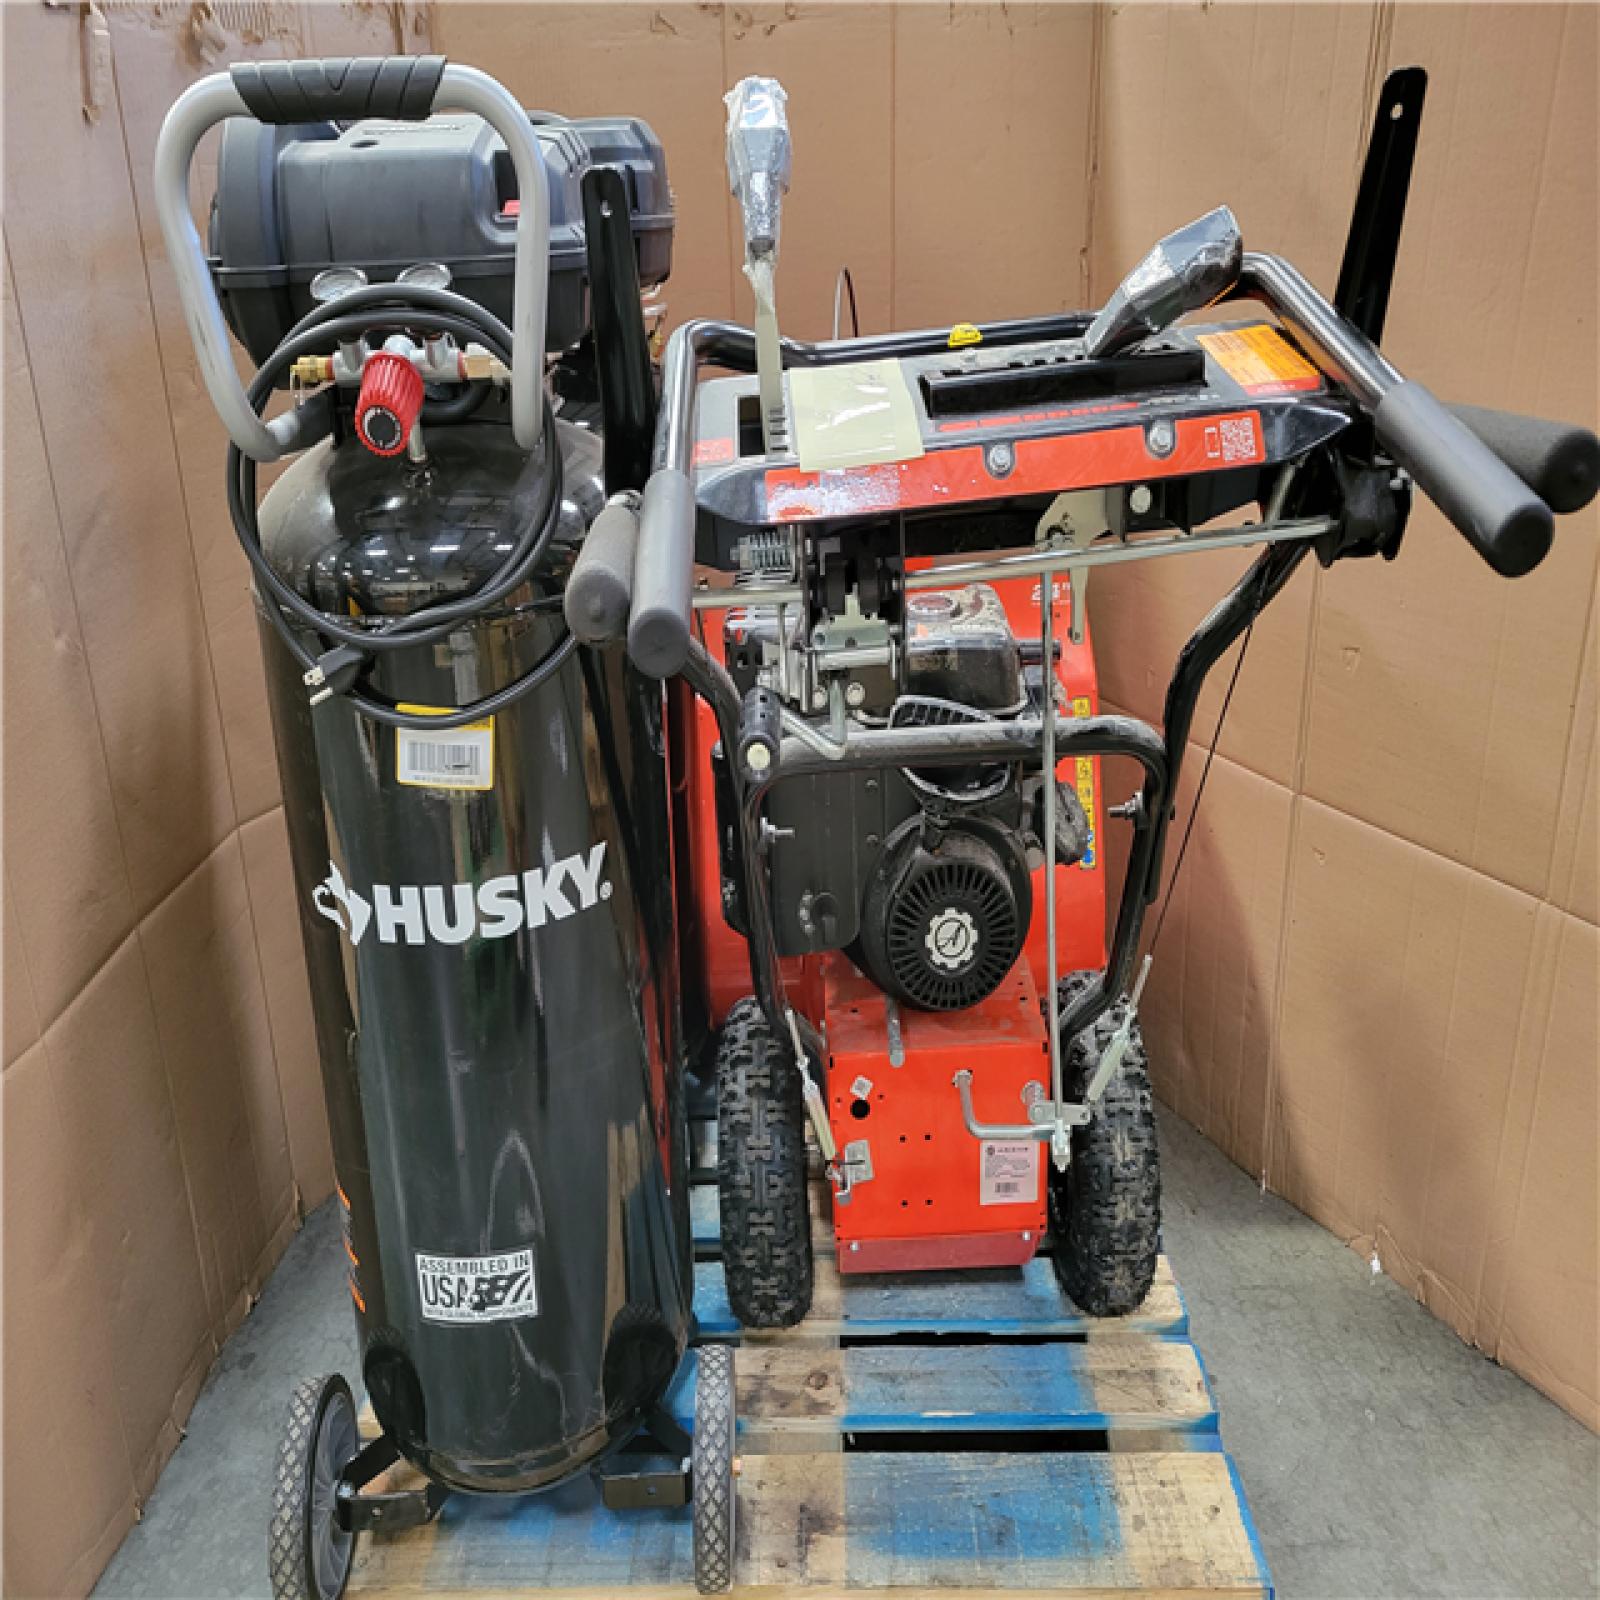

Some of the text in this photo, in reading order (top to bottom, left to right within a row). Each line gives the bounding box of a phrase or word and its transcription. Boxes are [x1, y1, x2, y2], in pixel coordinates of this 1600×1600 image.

[419, 1254, 529, 1276] ASSEMBLED IN
[422, 1272, 472, 1309] USA
